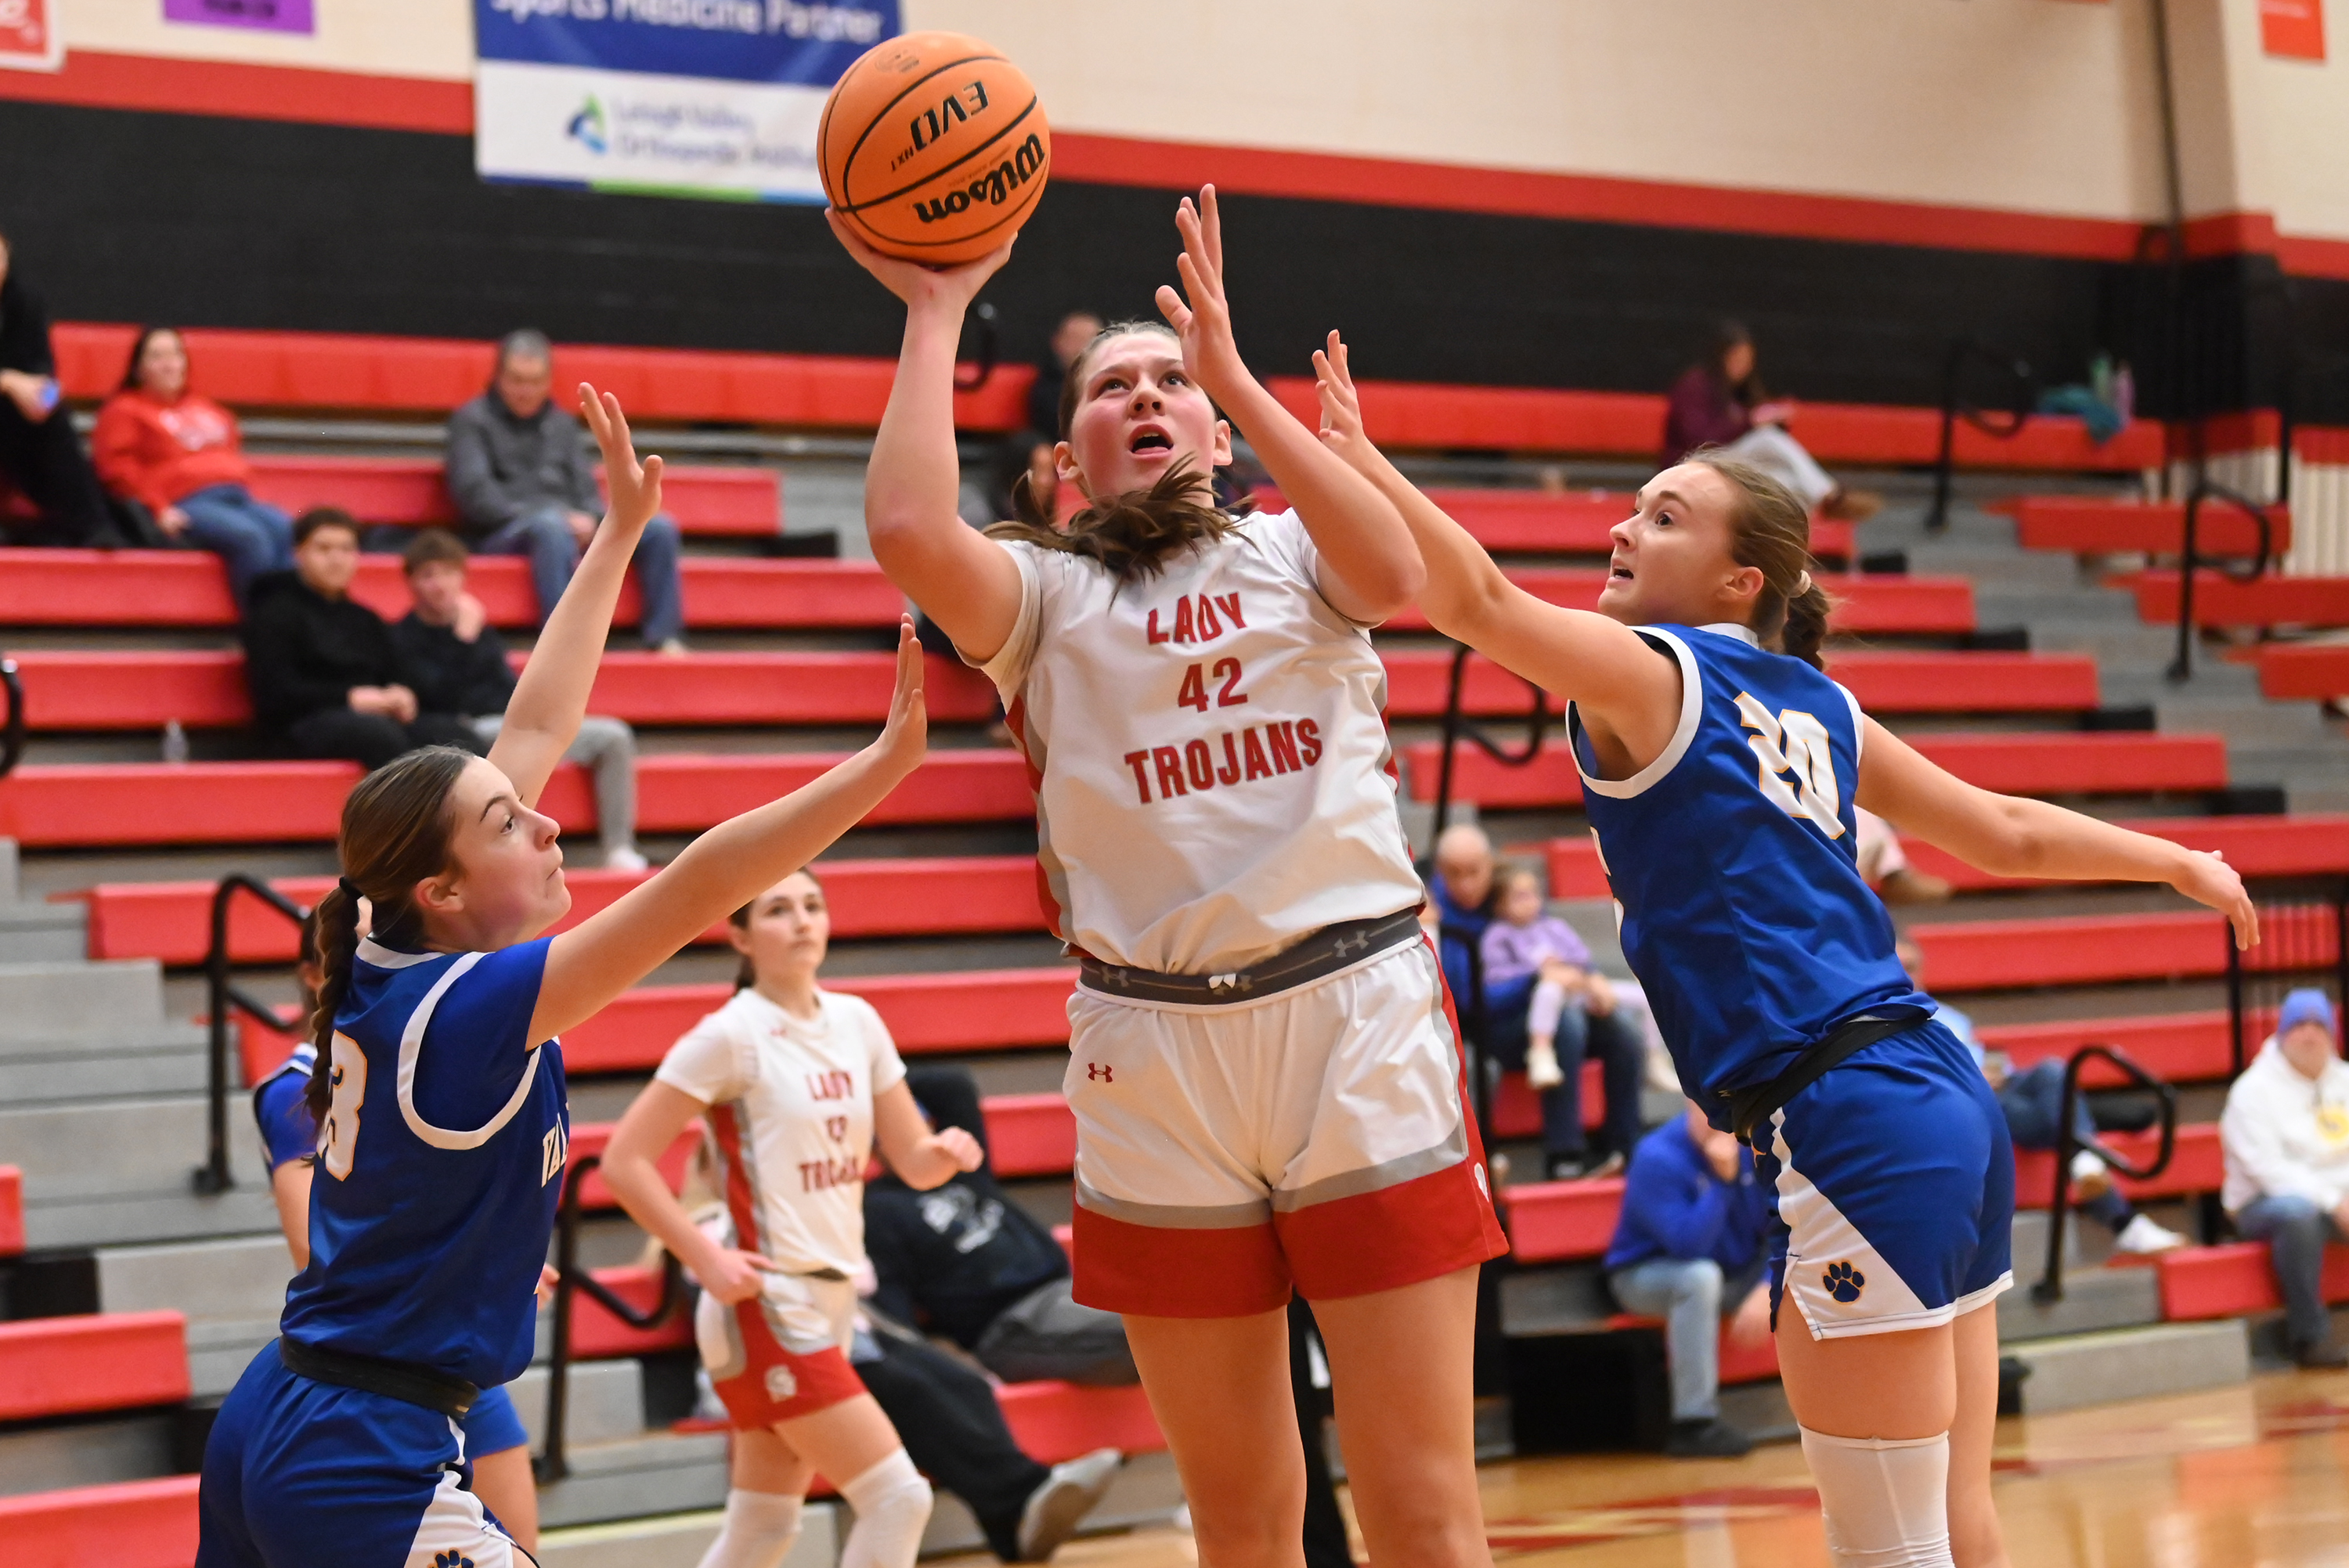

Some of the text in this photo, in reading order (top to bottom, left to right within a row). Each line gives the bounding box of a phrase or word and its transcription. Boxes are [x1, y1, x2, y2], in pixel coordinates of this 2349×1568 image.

[765, 1, 882, 45] Partner
[890, 146, 915, 172] NXT
[912, 133, 1045, 223] Wilson
[1147, 591, 1248, 645] LADY
[1178, 657, 1248, 713] 42
[1124, 718, 1322, 805] TROJANS
[1734, 690, 1846, 840] 20
